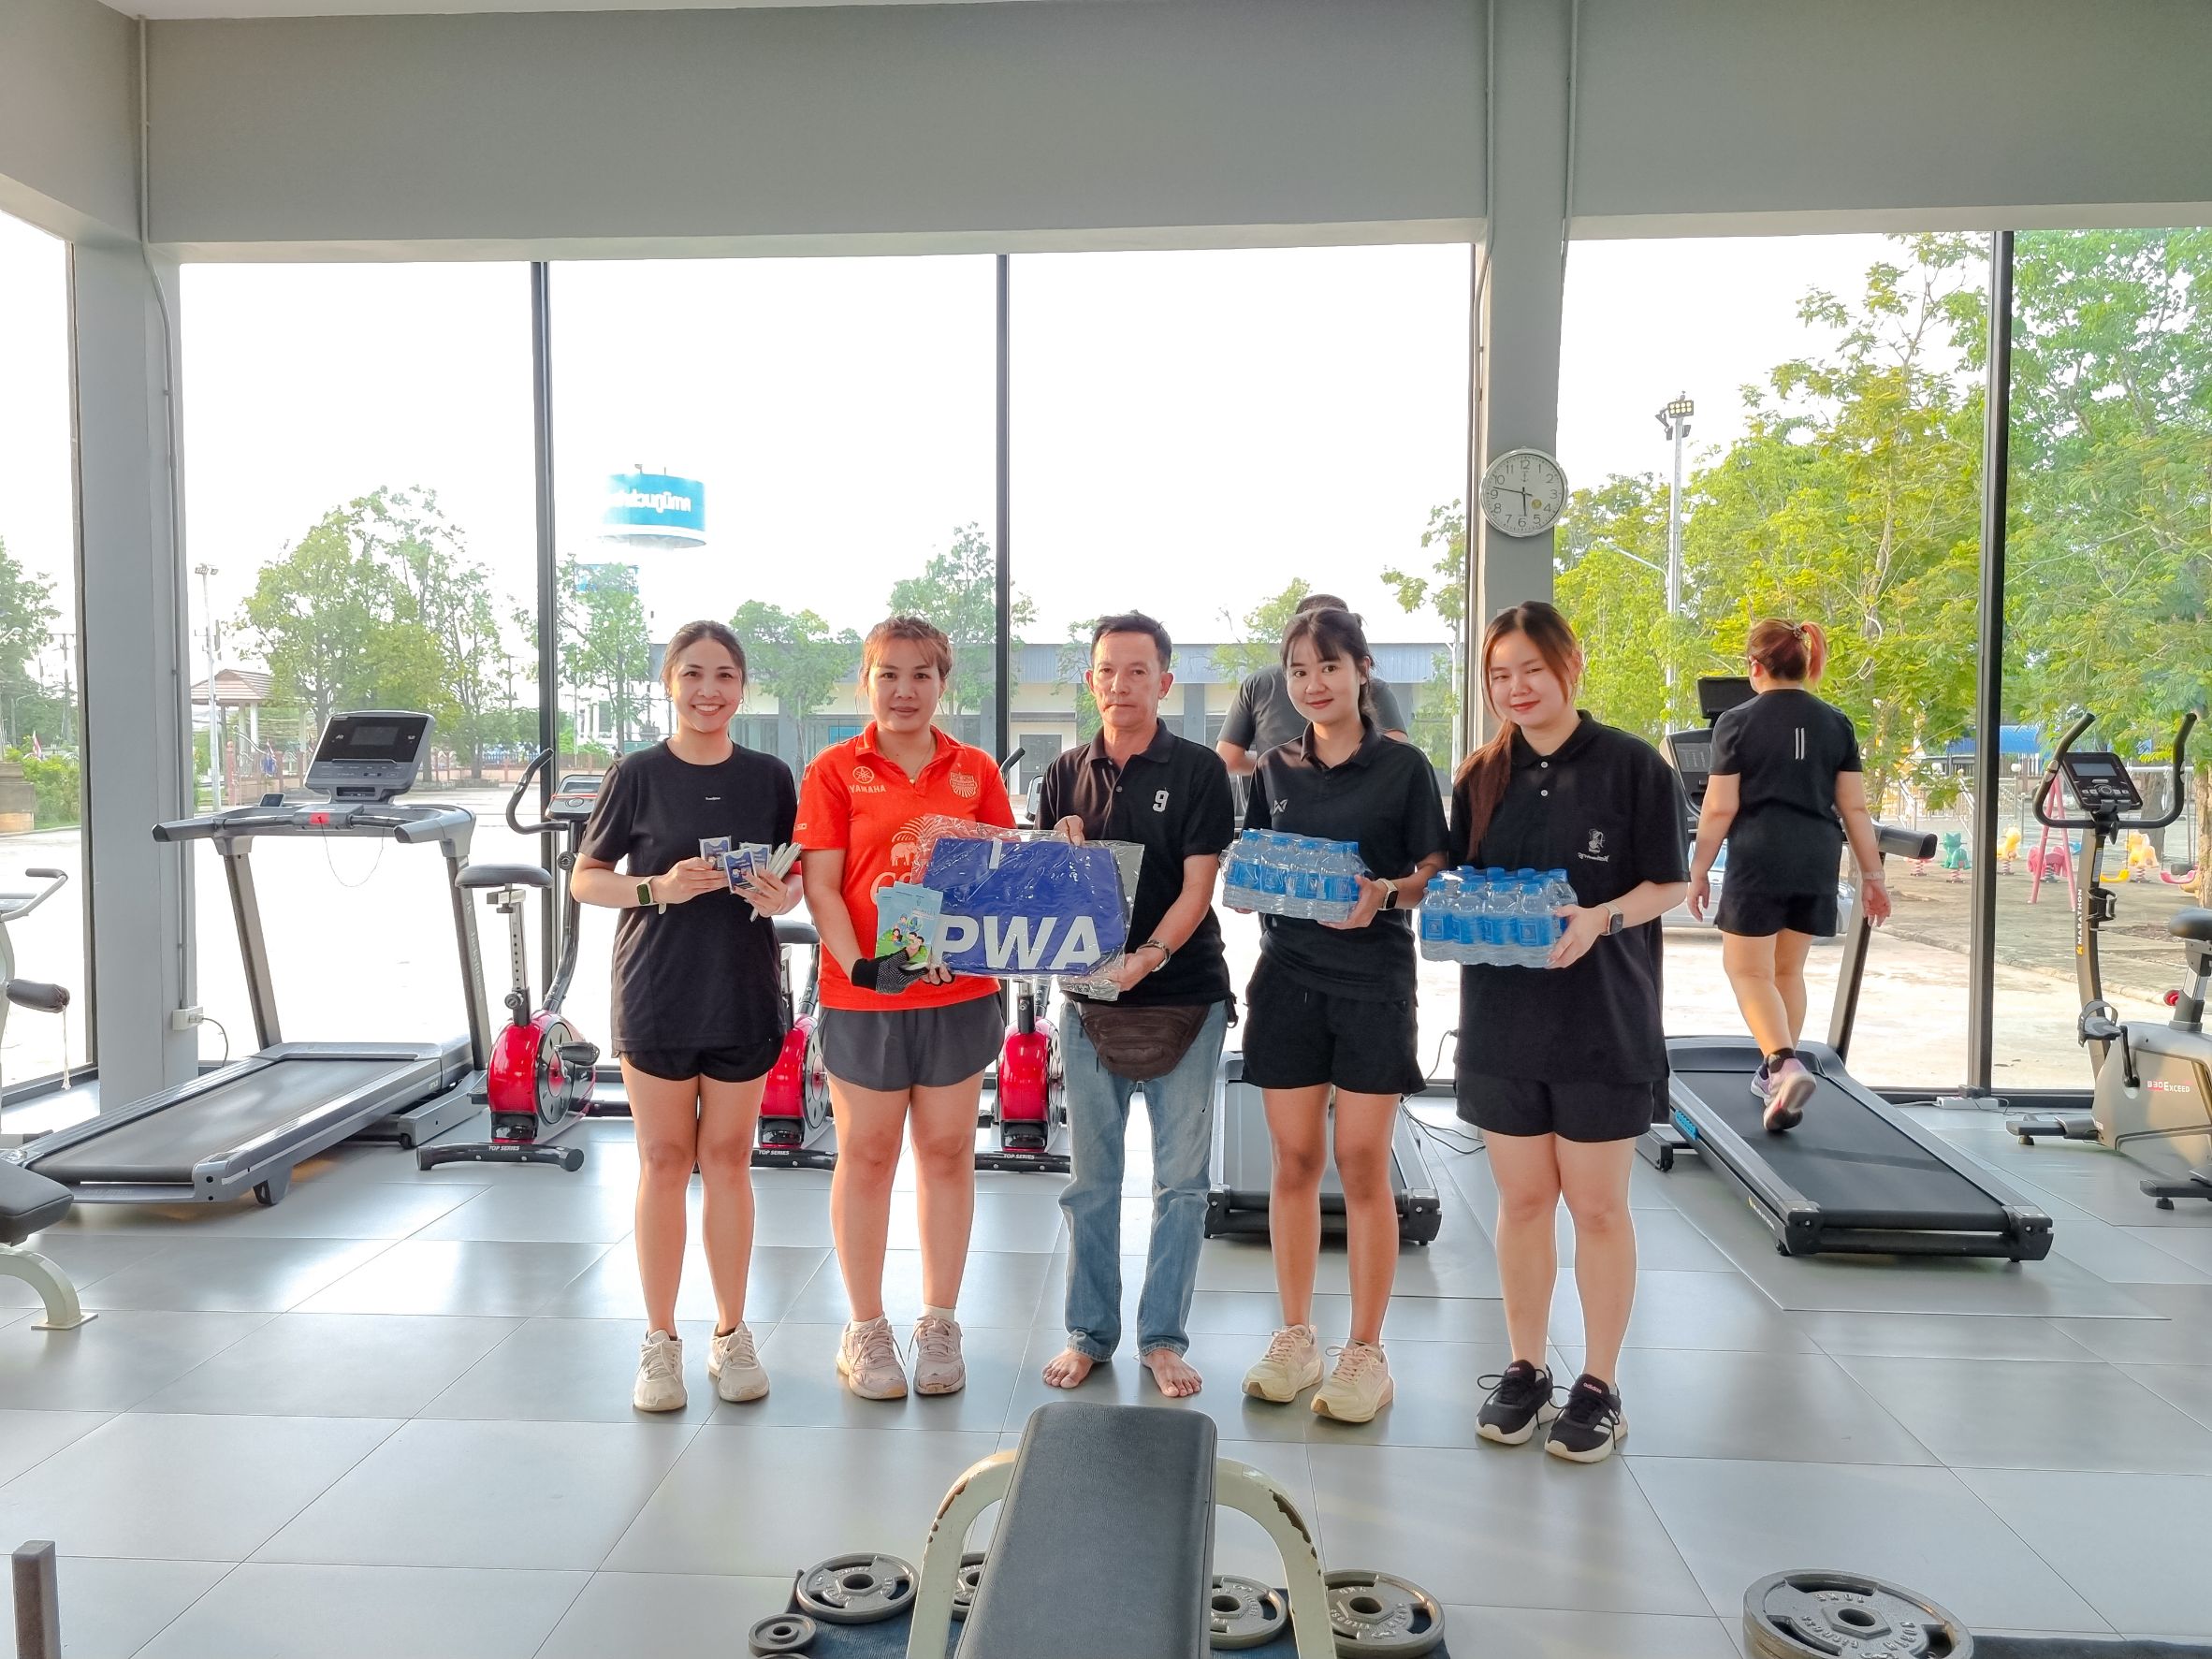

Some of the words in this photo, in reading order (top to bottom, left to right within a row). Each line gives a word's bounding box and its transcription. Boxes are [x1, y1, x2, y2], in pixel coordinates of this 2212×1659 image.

[1506, 463, 1514, 474] 11
[1520, 459, 1531, 470] 12
[1493, 474, 1506, 485] 10
[1545, 473, 1555, 484] 2
[1490, 489, 1499, 500] 9
[1549, 488, 1558, 500] 3
[1493, 502, 1502, 514] 8
[1543, 502, 1551, 514] 4
[1505, 514, 1513, 525] 7
[1518, 517, 1527, 528] 6
[1533, 514, 1541, 525] 5
[849, 784, 887, 793] YAMAHA
[1152, 790, 1170, 813] 9
[930, 913, 1102, 970] PWA
[1582, 1382, 1603, 1394] adidas
